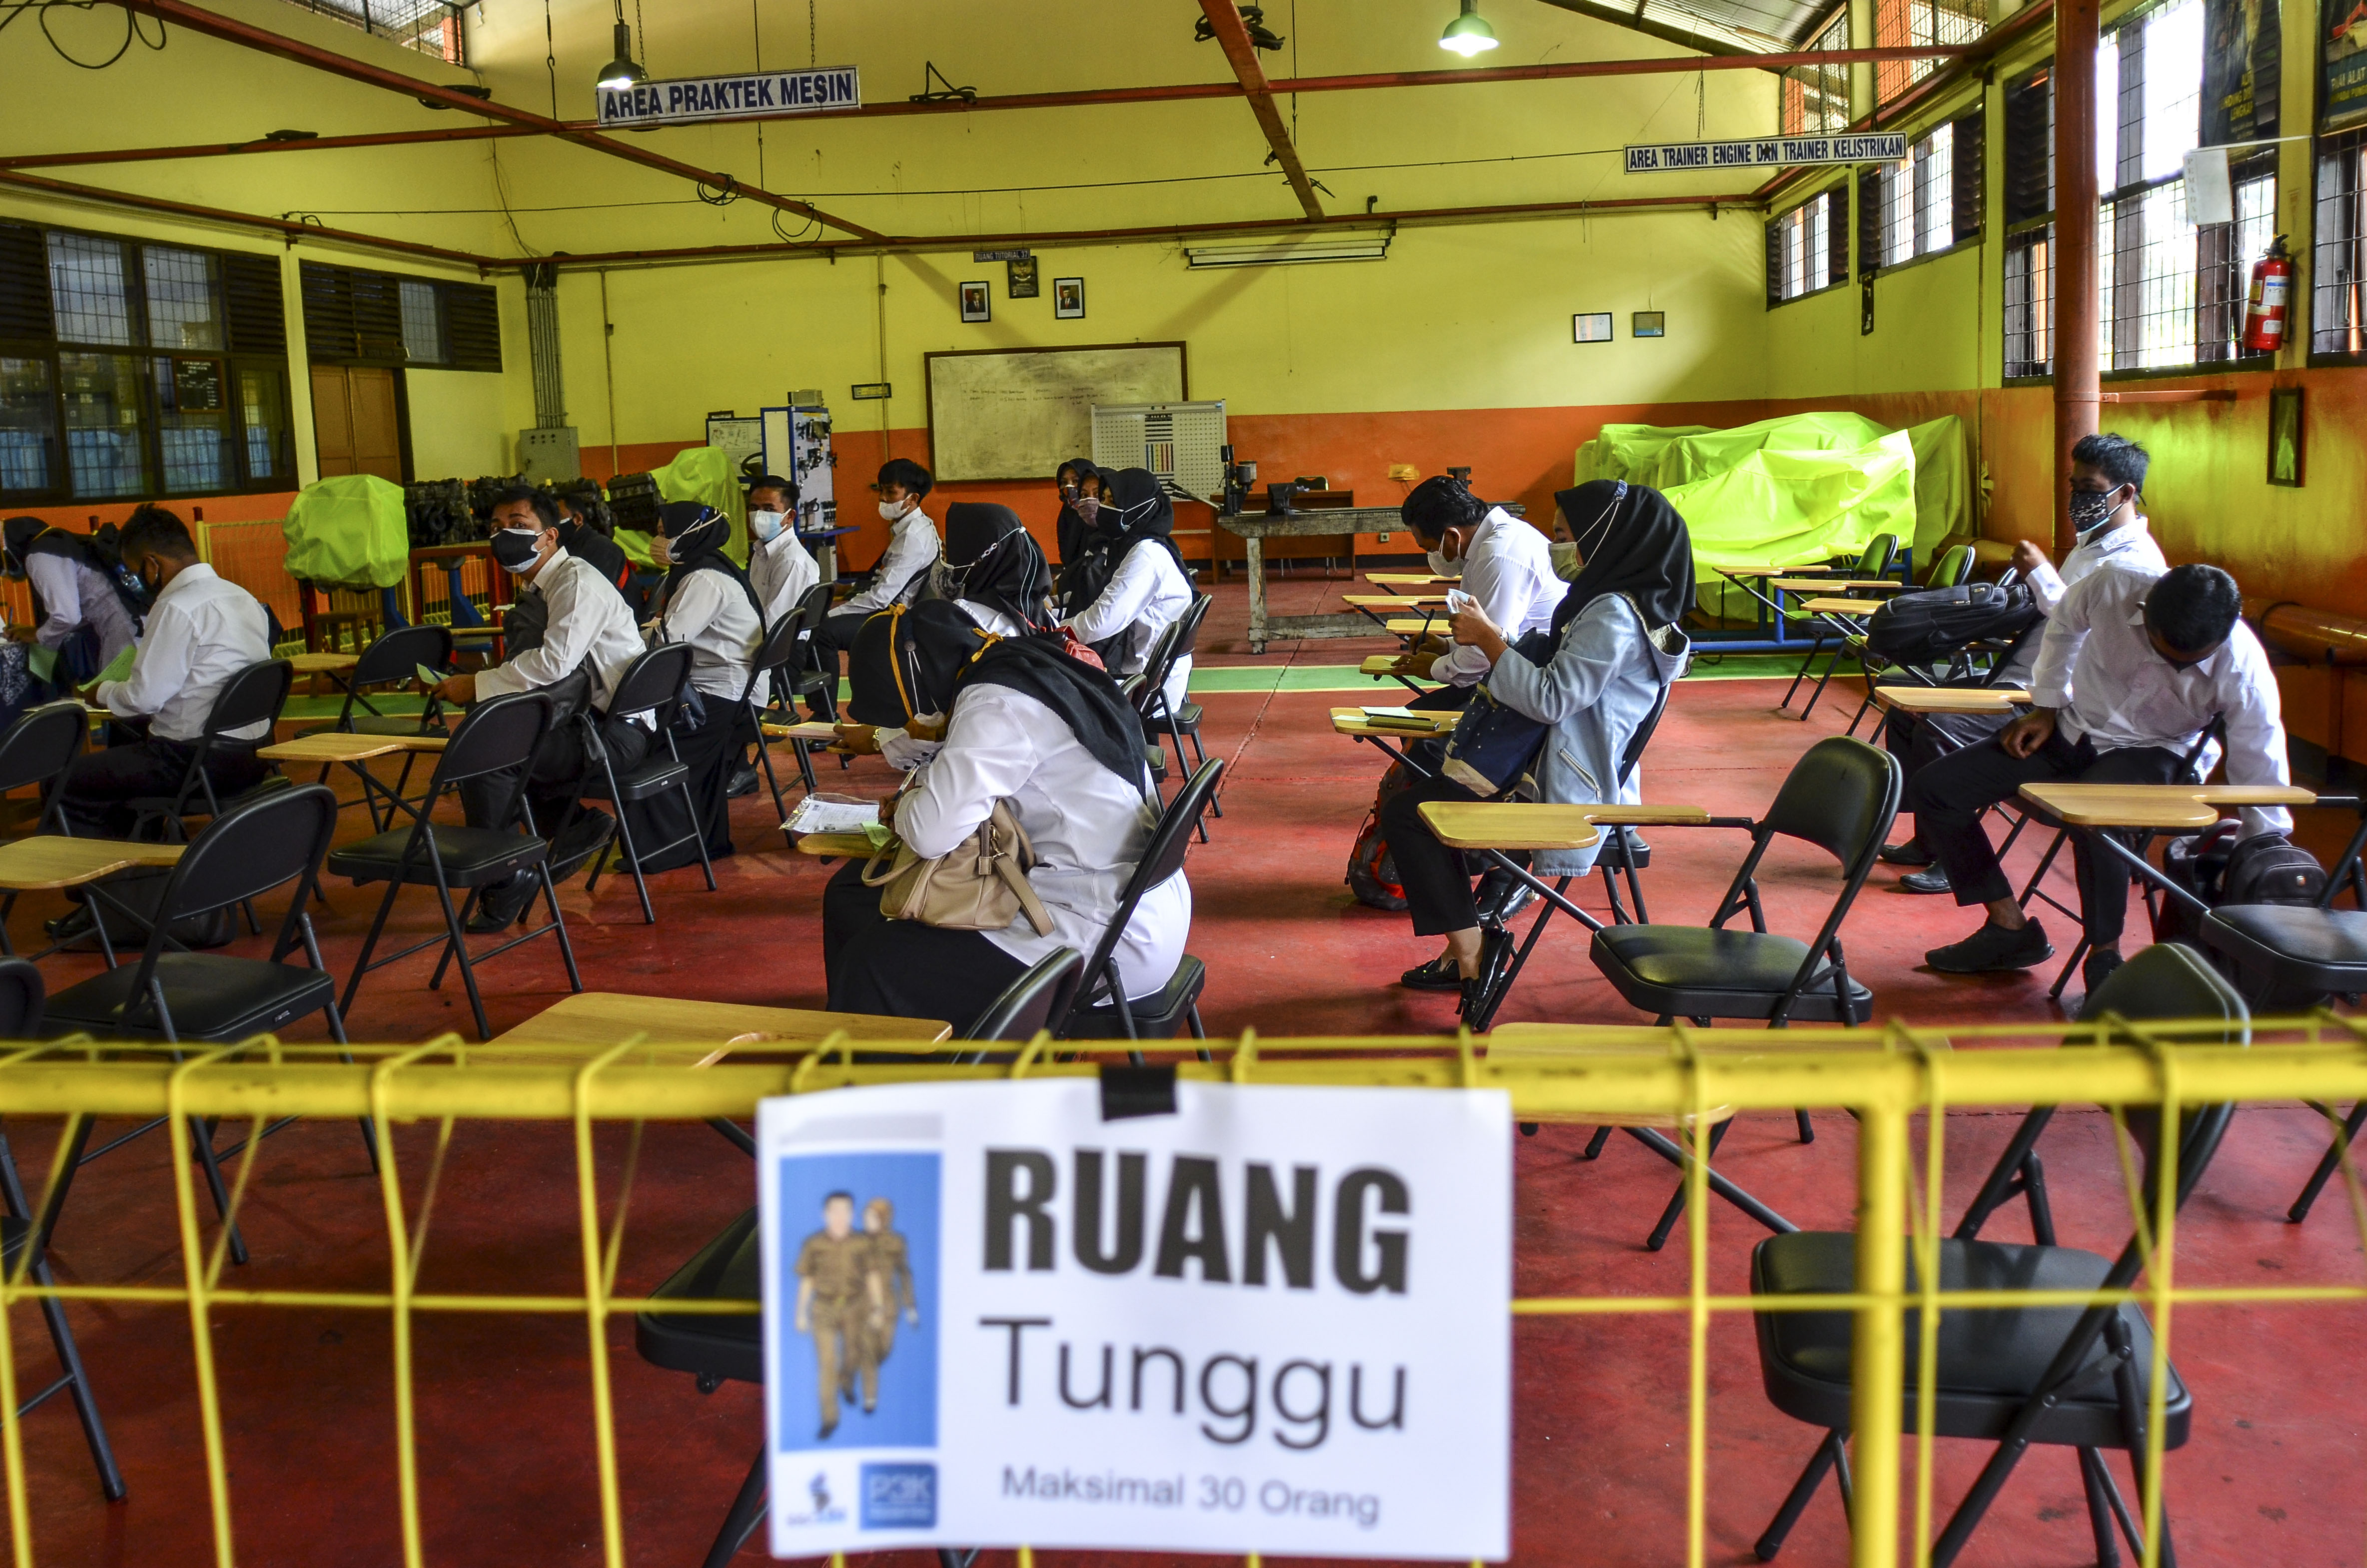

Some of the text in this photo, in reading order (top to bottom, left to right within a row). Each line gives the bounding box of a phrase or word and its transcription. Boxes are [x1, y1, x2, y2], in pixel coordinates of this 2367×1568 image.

[605, 73, 852, 119] AREA PRAKTEK MESIN
[1629, 136, 1903, 168] AREA TRAINER ENGINE DAN TRAINER KELISTRIKAN
[982, 1146, 1413, 1296] RUANG
[977, 1316, 1408, 1449] Tunggu
[1001, 1464, 1381, 1530] Maksimal 30 Orang
